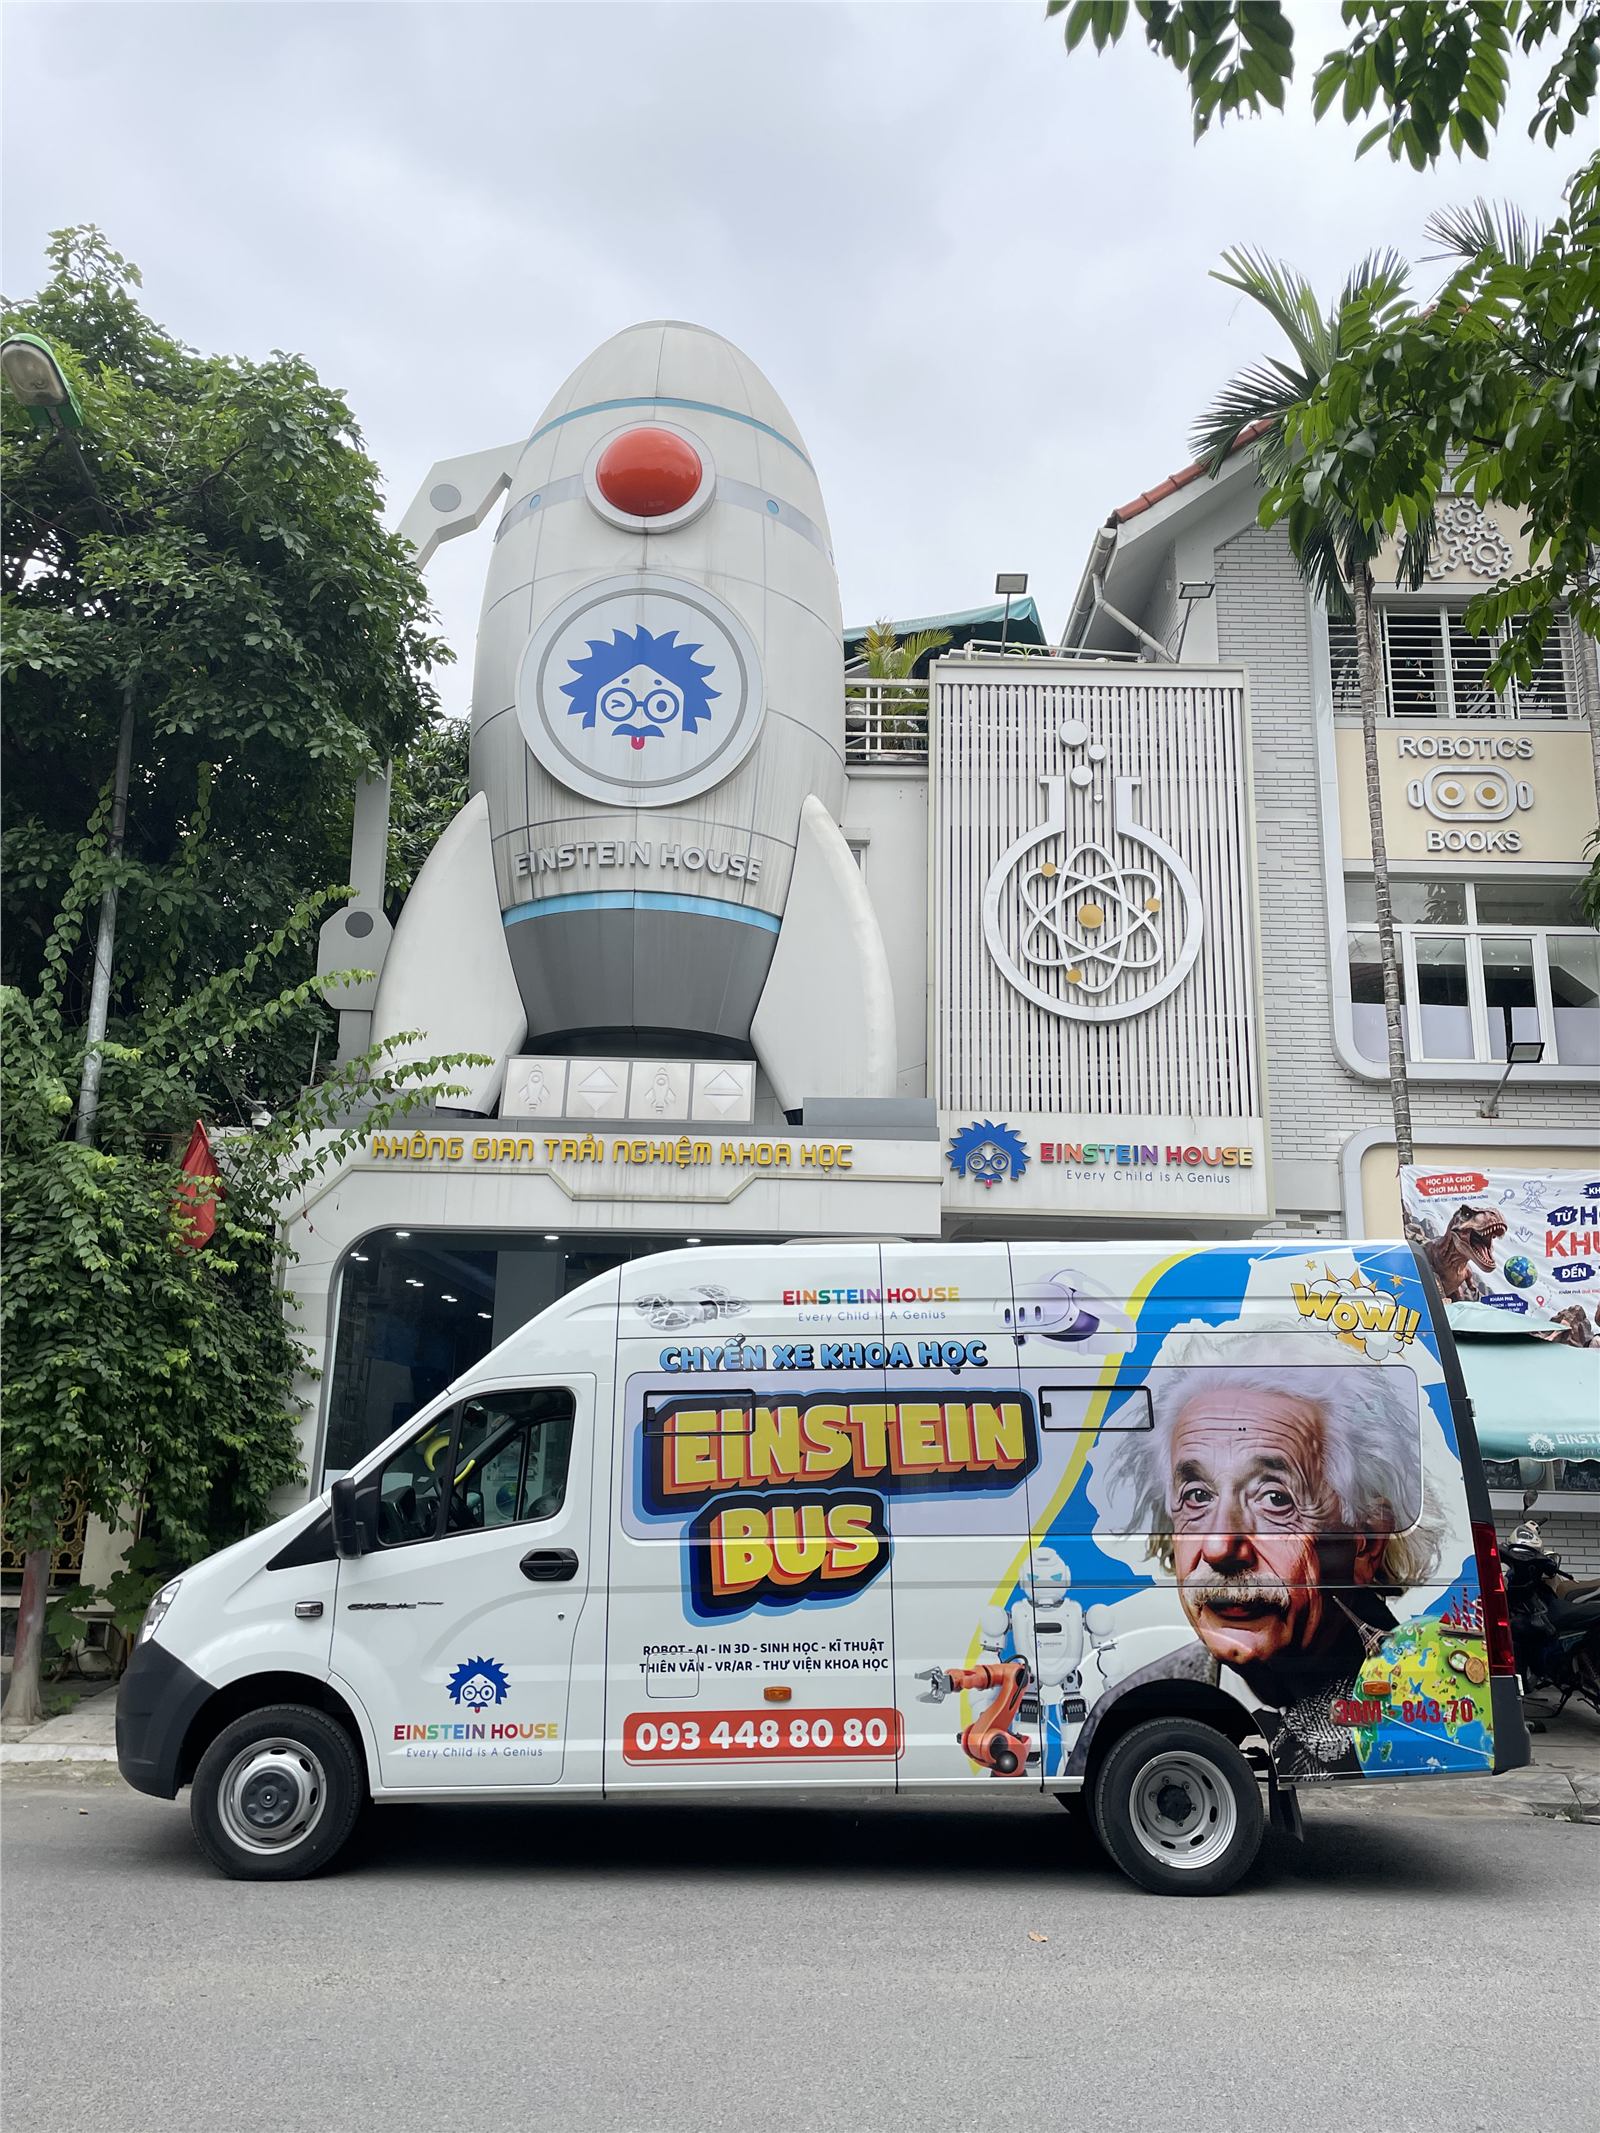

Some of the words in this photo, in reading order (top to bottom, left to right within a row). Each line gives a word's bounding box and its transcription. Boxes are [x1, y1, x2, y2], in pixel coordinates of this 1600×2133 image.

[1398, 735, 1535, 760] ROBOTICS
[1426, 830, 1523, 853] BOOKS
[514, 841, 651, 878] EINSTEIN
[660, 843, 763, 883] HOUSE
[372, 1130, 464, 1160] KHÔNG
[472, 1138, 534, 1162] GIAN
[544, 1133, 604, 1163] TRẢI
[612, 1135, 713, 1169] NGHIỆM
[720, 1142, 792, 1166] KHOA
[801, 1144, 853, 1173] HỌC
[1040, 1142, 1159, 1165] EINSTEIN
[1166, 1145, 1255, 1168] HOUSE
[1066, 1169, 1105, 1183] Every
[1113, 1170, 1154, 1182] Child
[1160, 1171, 1171, 1182] is
[1174, 1172, 1184, 1182] A
[1187, 1172, 1231, 1184] Genius
[1555, 1209, 1573, 1223] TỪ
[1580, 1205, 1600, 1225] H
[1561, 1264, 1587, 1279] ĐẾN
[782, 1288, 881, 1305] EINSTEIN
[887, 1287, 961, 1303] HOUSE
[798, 1312, 832, 1323] Every
[838, 1311, 870, 1321] Child
[890, 1311, 898, 1320] A
[903, 1310, 946, 1320] Genius
[772, 1343, 815, 1370] XE
[820, 1341, 913, 1370] KHOA
[918, 1340, 989, 1375] HỌC
[663, 1402, 1034, 1495] EINSTEIN
[709, 1504, 881, 1597] BUS
[643, 1644, 686, 1656] ROBOT
[696, 1644, 709, 1655] AI
[718, 1644, 731, 1654] IN
[734, 1644, 750, 1654] 3D
[760, 1643, 790, 1654] SINH
[793, 1642, 819, 1656] HỌC
[829, 1638, 842, 1652] KĨ
[843, 1638, 885, 1654] THUẬT
[639, 1661, 676, 1674] THIÊN
[679, 1659, 704, 1673] VĂN
[715, 1661, 753, 1674] VR/AR
[763, 1659, 790, 1671] THƯ
[791, 1656, 822, 1673] VIỆN
[824, 1658, 860, 1670] KHOA
[862, 1658, 889, 1672] HỌC
[1402, 1699, 1474, 1724] 843.70
[393, 1724, 486, 1740] EINSTEIN
[490, 1723, 559, 1739] HOUSE
[636, 1722, 701, 1752] 093
[709, 1719, 780, 1750] 448
[789, 1719, 834, 1748] 80
[842, 1718, 888, 1747] 80
[406, 1748, 438, 1760] Every
[443, 1747, 473, 1758] Child
[477, 1748, 487, 1758] is
[490, 1748, 498, 1757] A
[503, 1746, 543, 1758] Genius
